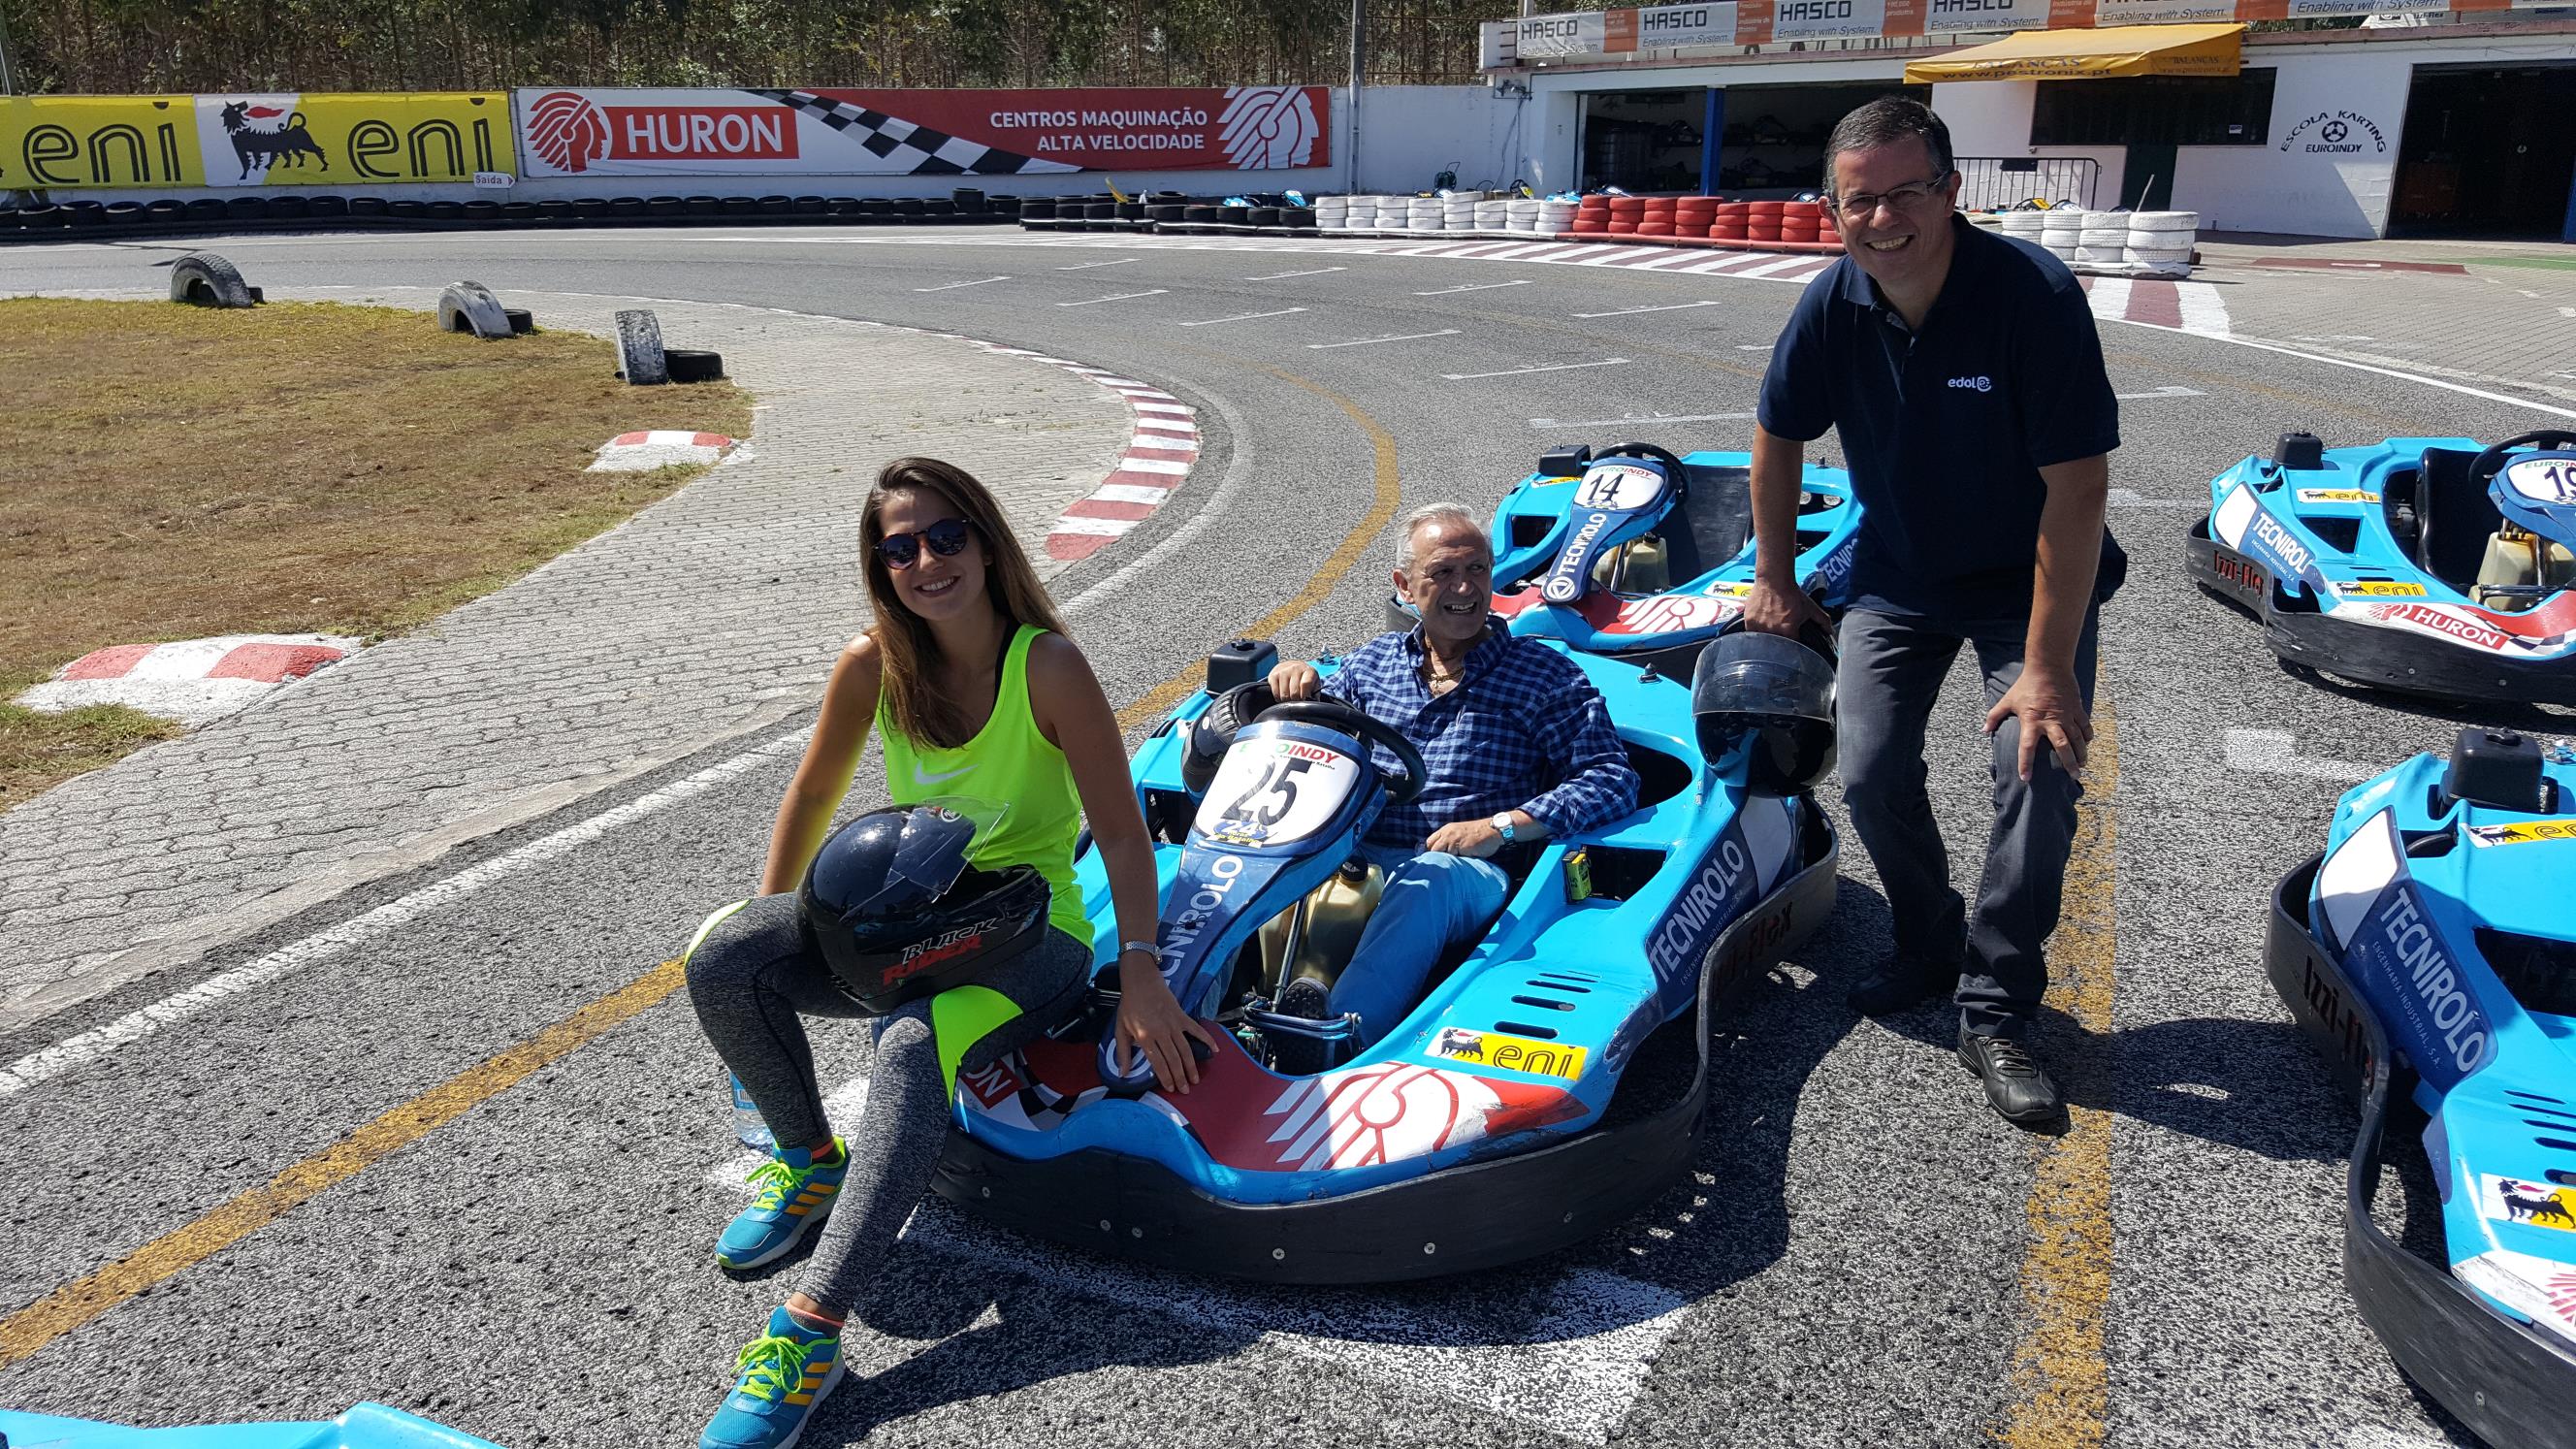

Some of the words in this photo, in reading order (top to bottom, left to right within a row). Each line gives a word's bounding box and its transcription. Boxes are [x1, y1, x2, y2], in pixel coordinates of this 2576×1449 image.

[1643, 10, 1708, 30] HASCO
[1780, 0, 1852, 21] HASCO
[2103, 12, 2152, 22] Enabling
[2154, 10, 2178, 19] with
[2297, 0, 2353, 13] Enabling
[2357, 0, 2383, 10] with
[1521, 20, 1578, 40] HASCO
[1778, 28, 1816, 39] Enabling
[1818, 26, 1837, 36] with
[1931, 20, 1973, 30] Enabling
[1976, 19, 1996, 28] with
[1643, 36, 1676, 47] Enabling
[990, 111, 1078, 128] CENTROS
[1081, 107, 1208, 129] MAQUINAÇÃO
[2281, 113, 2328, 151] ESCOLA
[2338, 110, 2386, 152] KARTING
[23, 101, 182, 184] eni
[347, 97, 495, 178] eni
[626, 113, 783, 153] HURON
[1037, 136, 1085, 151] ALTA
[1088, 134, 1205, 150] VELOCIDADE
[2305, 144, 2362, 152] EUROINDY
[1587, 473, 1624, 501] 14
[1556, 513, 1607, 575] TECNIROLO
[2372, 582, 2421, 596] eni
[2413, 609, 2499, 646] HURON
[1220, 756, 1313, 826] 25
[1650, 840, 1744, 983] TECNIROLO
[901, 917, 1000, 965] BLACK
[2372, 939, 2400, 993] ENGENHARIA
[2380, 886, 2485, 1073] TECNIROLO
[1493, 1045, 1576, 1077] eni
